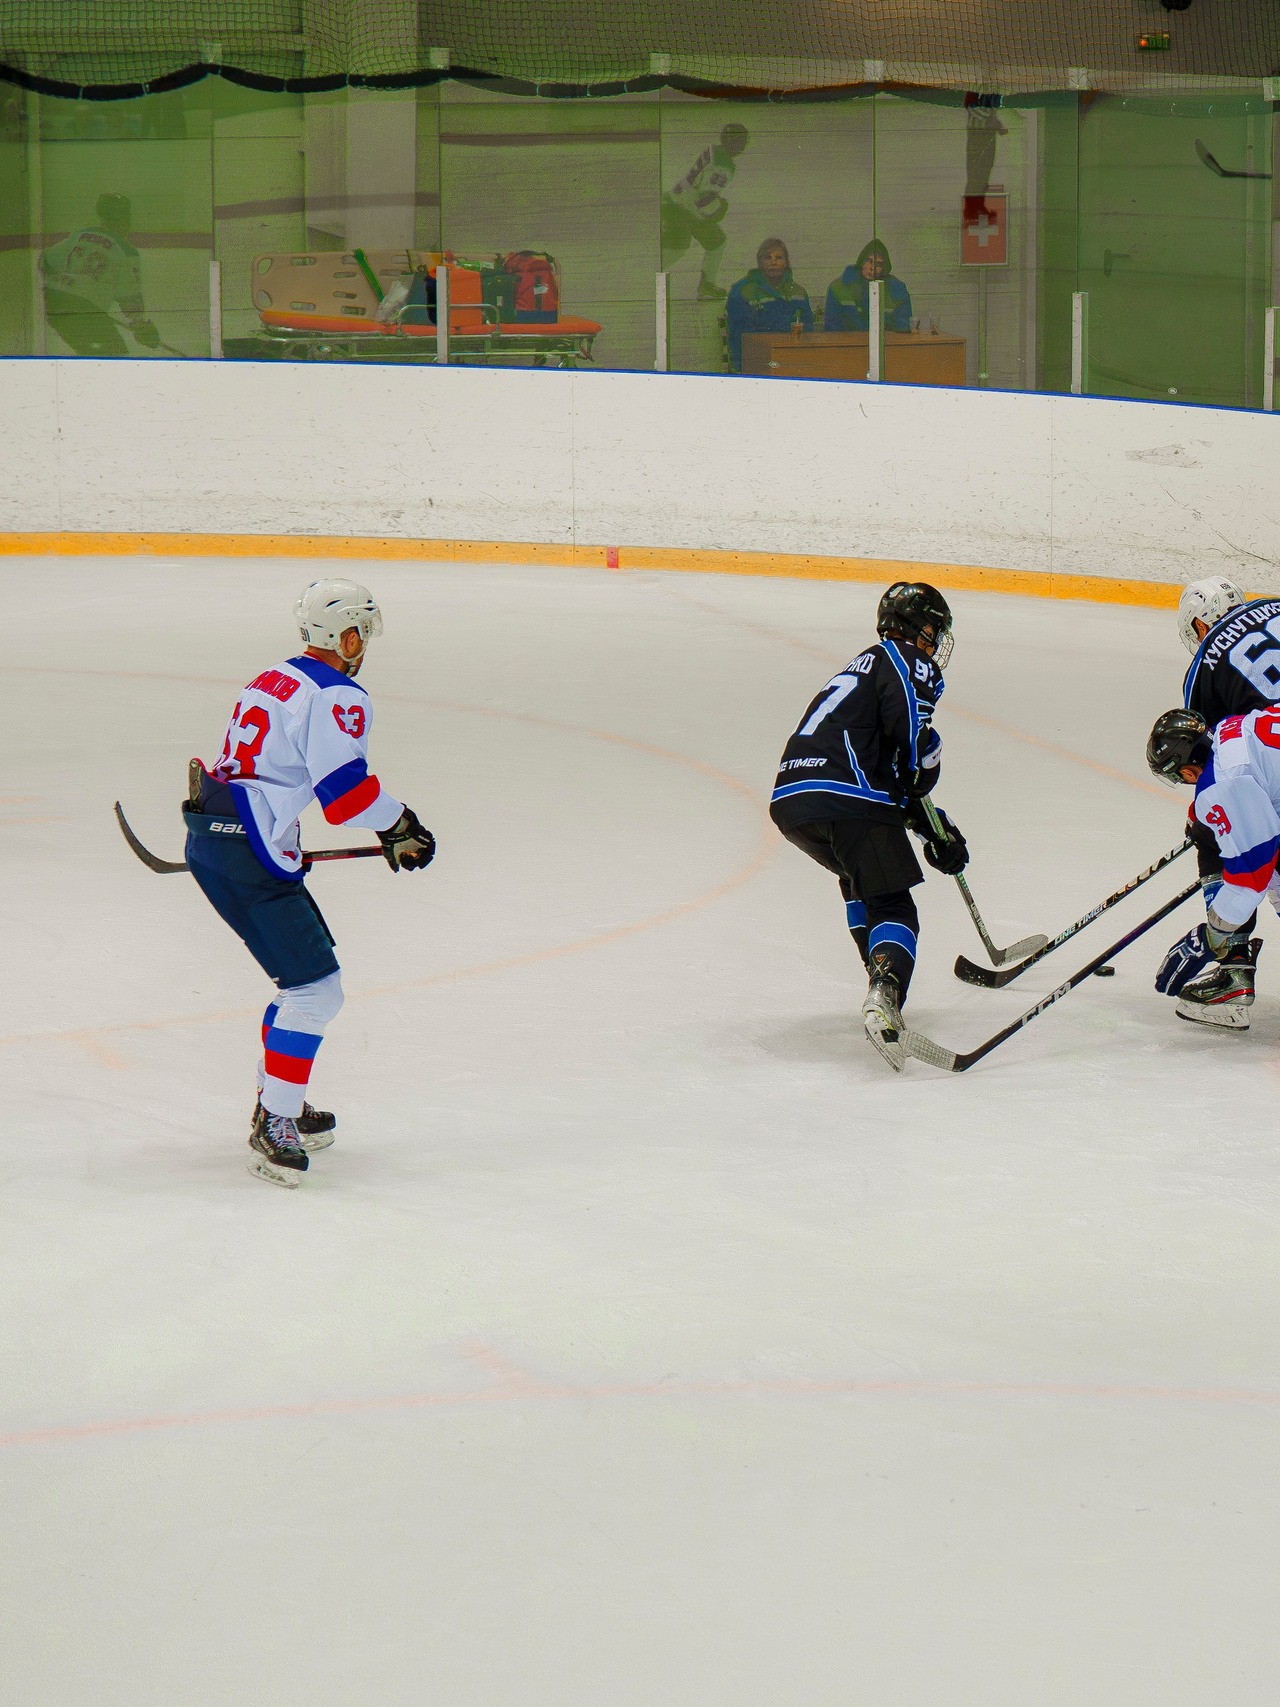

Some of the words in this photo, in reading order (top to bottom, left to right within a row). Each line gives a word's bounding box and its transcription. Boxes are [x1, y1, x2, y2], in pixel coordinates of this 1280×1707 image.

[244, 669, 302, 702] НИКОВ
[797, 673, 860, 737] 7
[788, 757, 828, 770] TIMER
